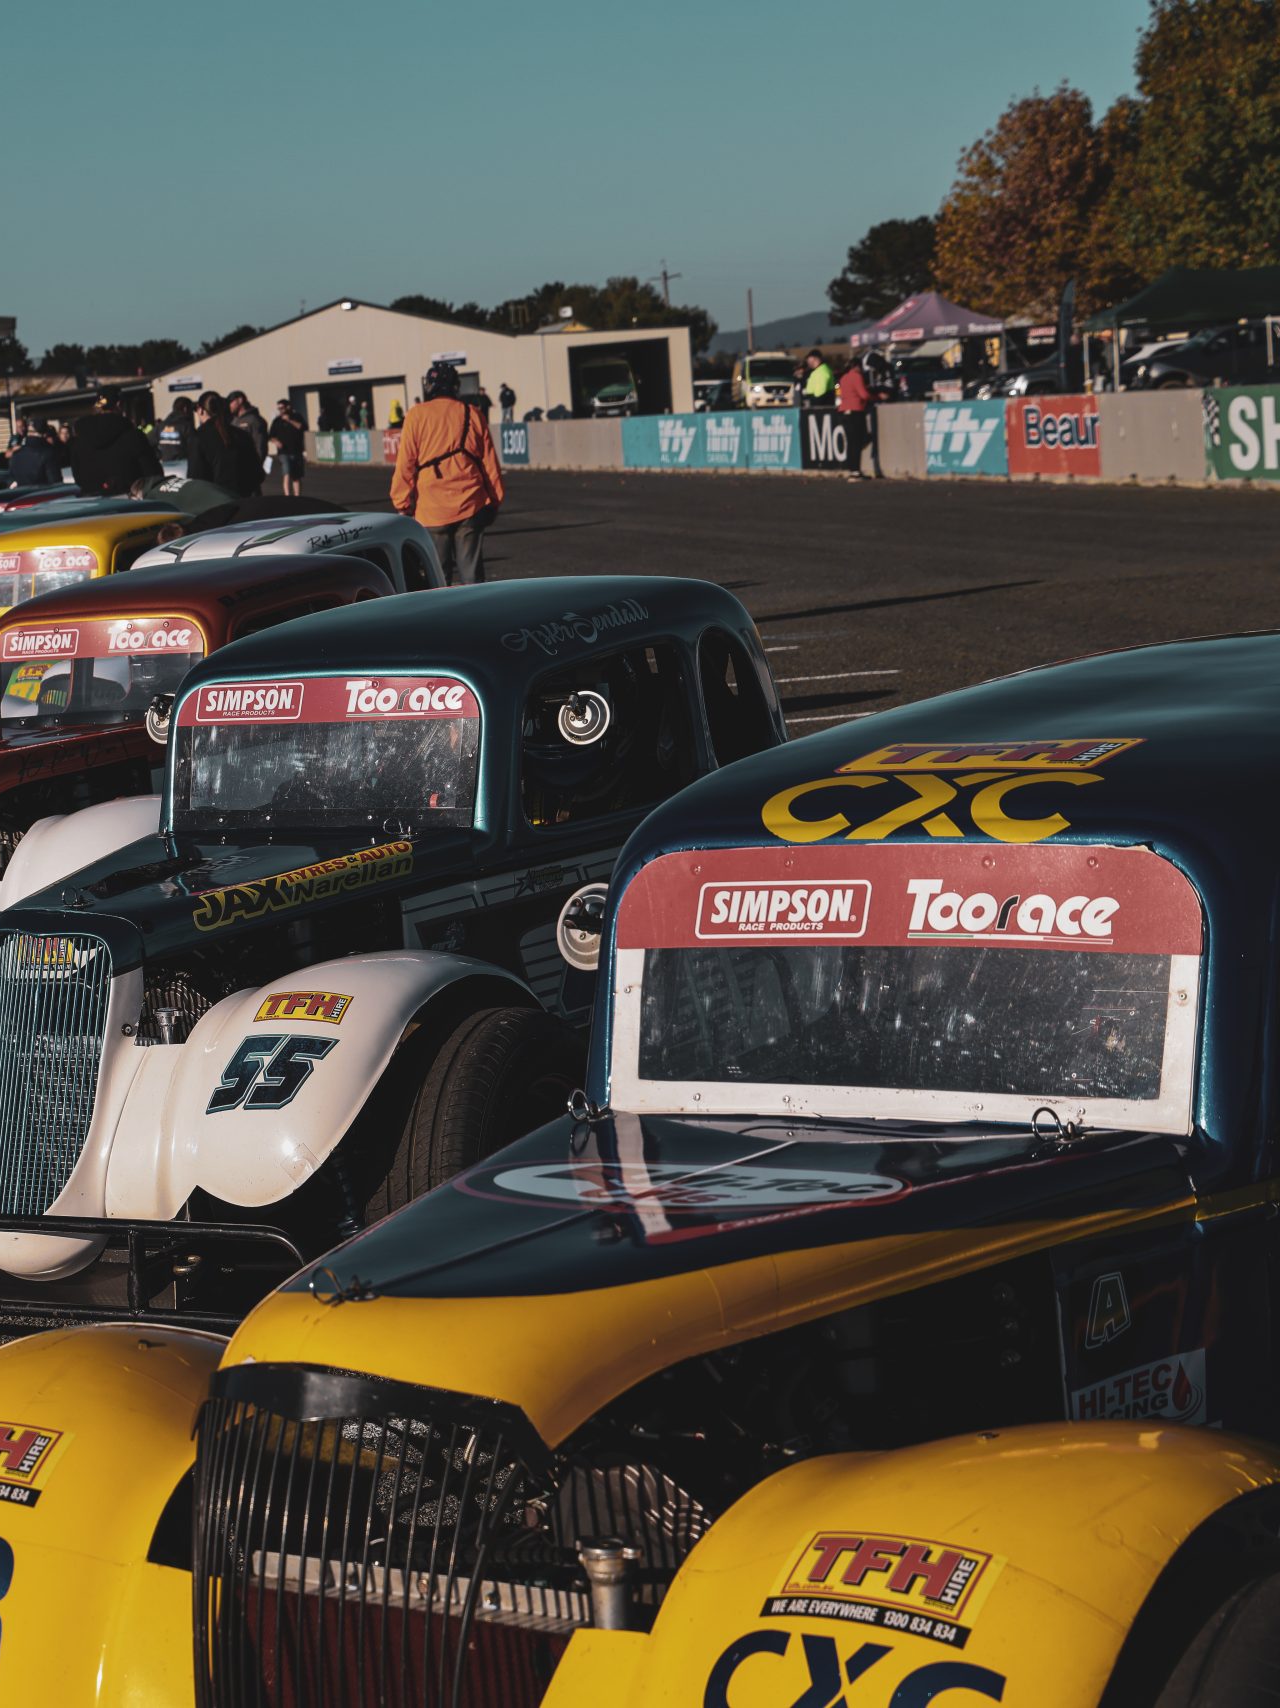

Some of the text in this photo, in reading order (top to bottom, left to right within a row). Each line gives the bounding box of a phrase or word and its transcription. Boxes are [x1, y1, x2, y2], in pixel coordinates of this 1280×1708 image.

[502, 429, 526, 454] 1300
[808, 413, 848, 462] Mo
[38, 555, 92, 568] Tooace
[10, 632, 72, 652] SIMPSON
[205, 680, 467, 714] SIMPSON Toorace
[878, 742, 1122, 764] TFH HIRE
[761, 771, 1106, 844] CXC
[283, 859, 348, 883] TYRES
[360, 842, 411, 864] AUTO
[193, 856, 412, 931] JAX Narellan
[710, 879, 1121, 937] SIMPSON Toorace
[738, 922, 824, 931] RACE PRODUCTS
[265, 992, 347, 1018] TFH HIRE
[205, 1033, 339, 1115] 55
[1078, 1363, 1173, 1419] HI-TEC
[1104, 1392, 1169, 1419] CING
[19, 1435, 50, 1473] HIRE
[10, 1489, 30, 1503] 834
[808, 1538, 977, 1605] TFH HIRE
[771, 1598, 958, 1641] WE ARE EVERYWHERE 1300 834 834
